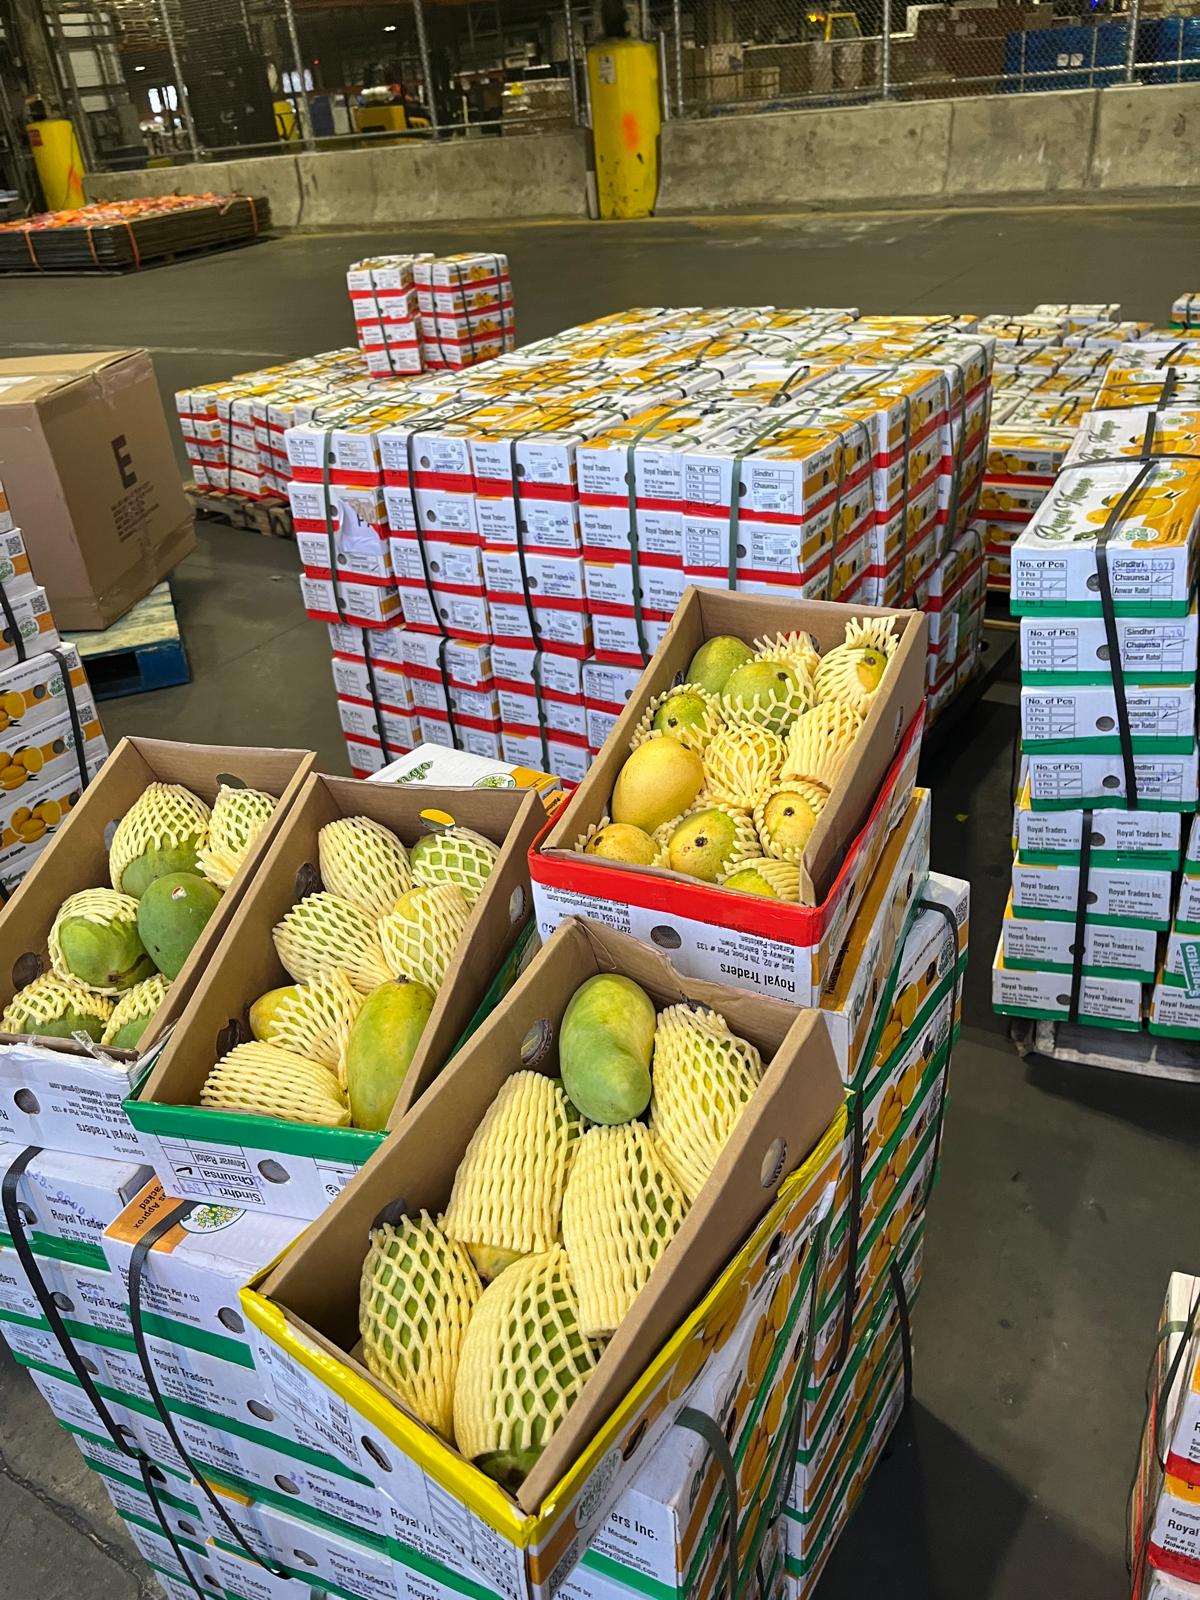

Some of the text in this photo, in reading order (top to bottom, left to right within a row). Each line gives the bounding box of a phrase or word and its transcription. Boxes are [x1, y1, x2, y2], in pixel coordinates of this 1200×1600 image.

[644, 468, 655, 476] Royal
[645, 527, 656, 536] Royal
[1019, 560, 1035, 568] No.
[1037, 560, 1046, 568] of
[1114, 560, 1144, 568] Sindhri
[1114, 573, 1150, 582] Chaunsa
[1126, 627, 1156, 636] Sindhri
[397, 760, 434, 785] ngo
[1027, 826, 1044, 834] Royal
[1116, 829, 1174, 838] Royal Traders Inc.
[1020, 882, 1060, 891] Royal Traders
[1108, 888, 1164, 899] Royal Traders Inc.
[1008, 933, 1046, 942] Royal Traders
[1094, 940, 1110, 950] Royal
[1112, 942, 1133, 950] Traders
[720, 964, 795, 992] Royal Traders
[1001, 982, 1038, 992] Royal Traders
[1084, 992, 1100, 1001] Royal
[1102, 994, 1122, 1003] Traders
[1160, 1000, 1178, 1008] Royal
[76, 1124, 138, 1143] Royal Traders
[218, 1156, 246, 1169] Anwar
[204, 1170, 254, 1186] Chaunsa
[220, 1188, 260, 1202] Sindhri
[51, 1209, 76, 1224] Royal
[133, 1202, 160, 1228] Approx
[82, 1292, 104, 1306] Royal
[154, 1358, 214, 1387] Royal Traders
[184, 1430, 206, 1448] Royal
[208, 1440, 239, 1460] Traders
[390, 1506, 418, 1528] Royal
[636, 1520, 658, 1541] Inc.
[1168, 1518, 1199, 1536] Royal
[330, 1558, 390, 1588] Royal Traders
